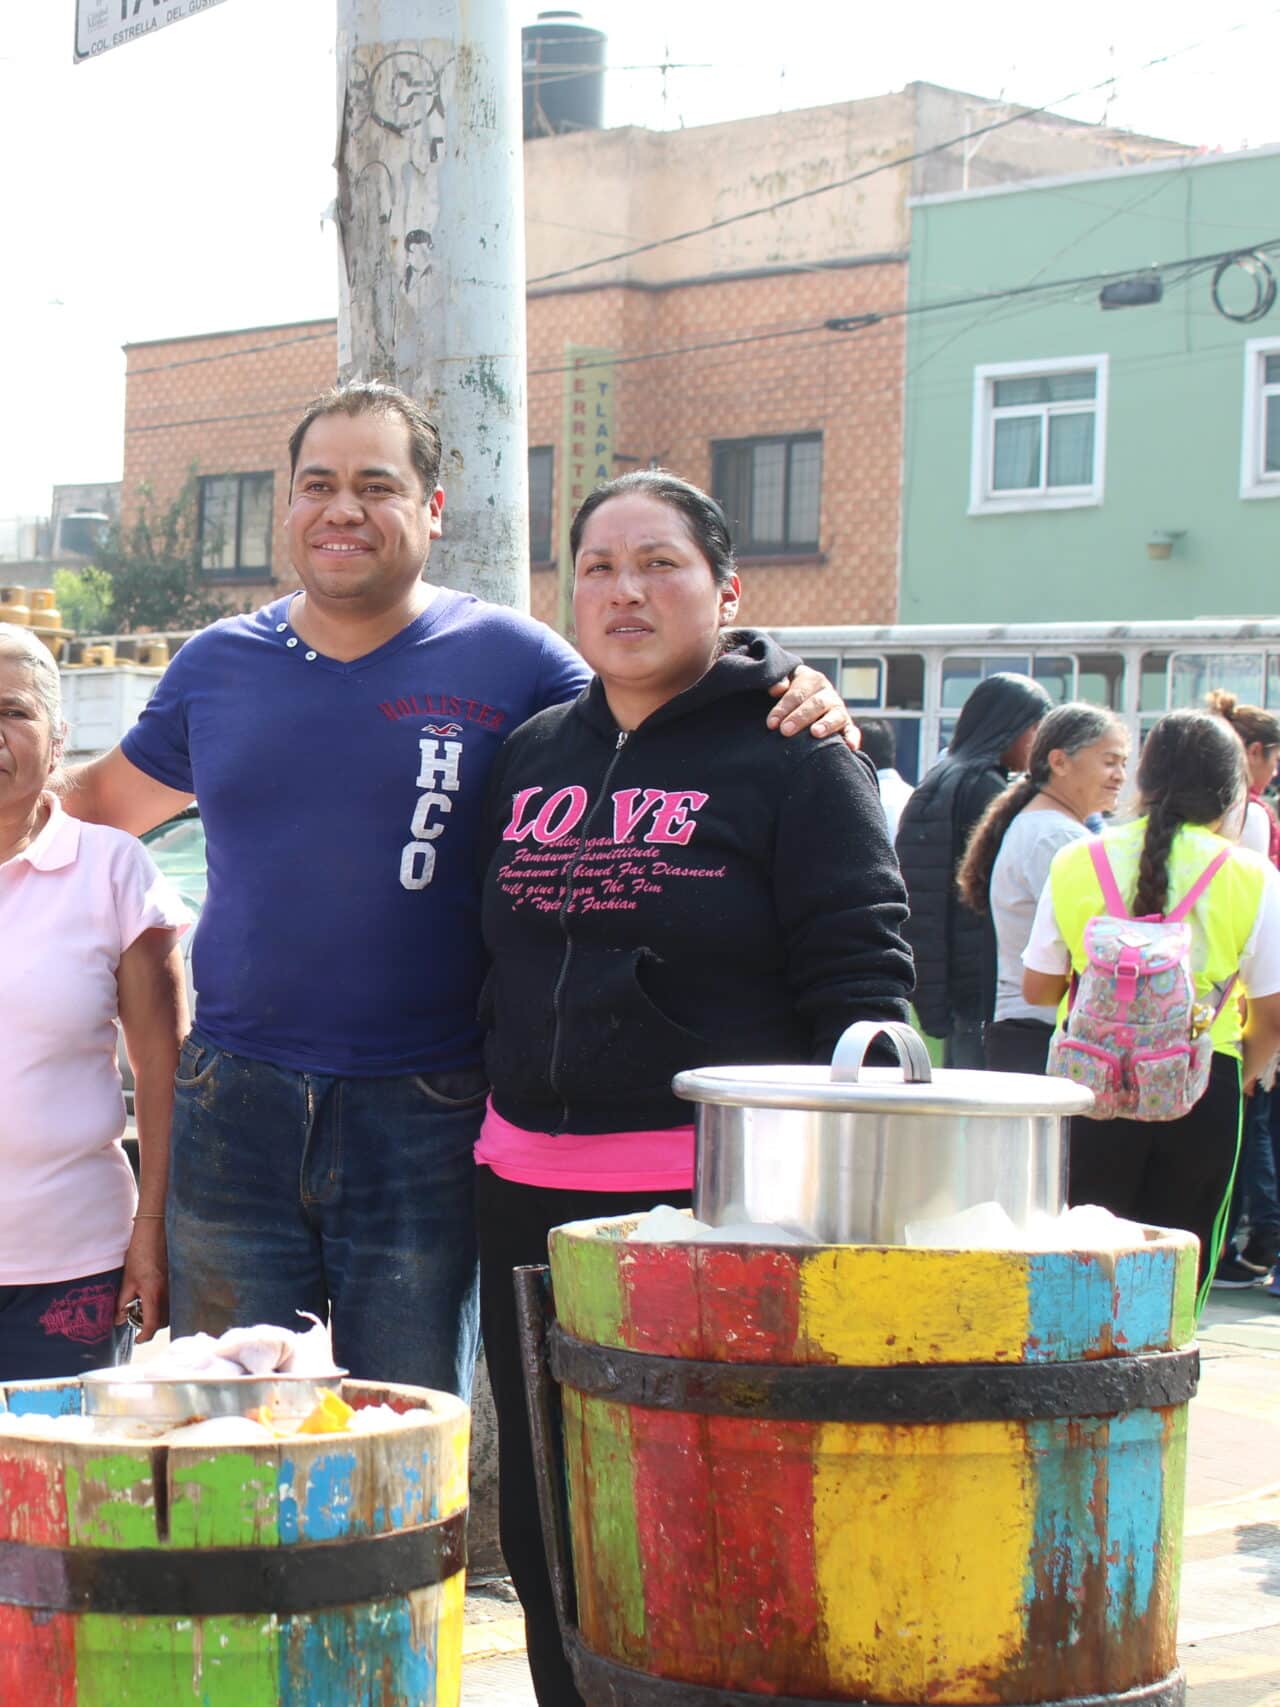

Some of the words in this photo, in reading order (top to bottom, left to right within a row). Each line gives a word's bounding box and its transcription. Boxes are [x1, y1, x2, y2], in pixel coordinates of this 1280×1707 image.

[113, 16, 158, 46] ESTRELLA
[594, 382, 609, 478] TLAPA
[378, 693, 505, 732] HOLLISTER
